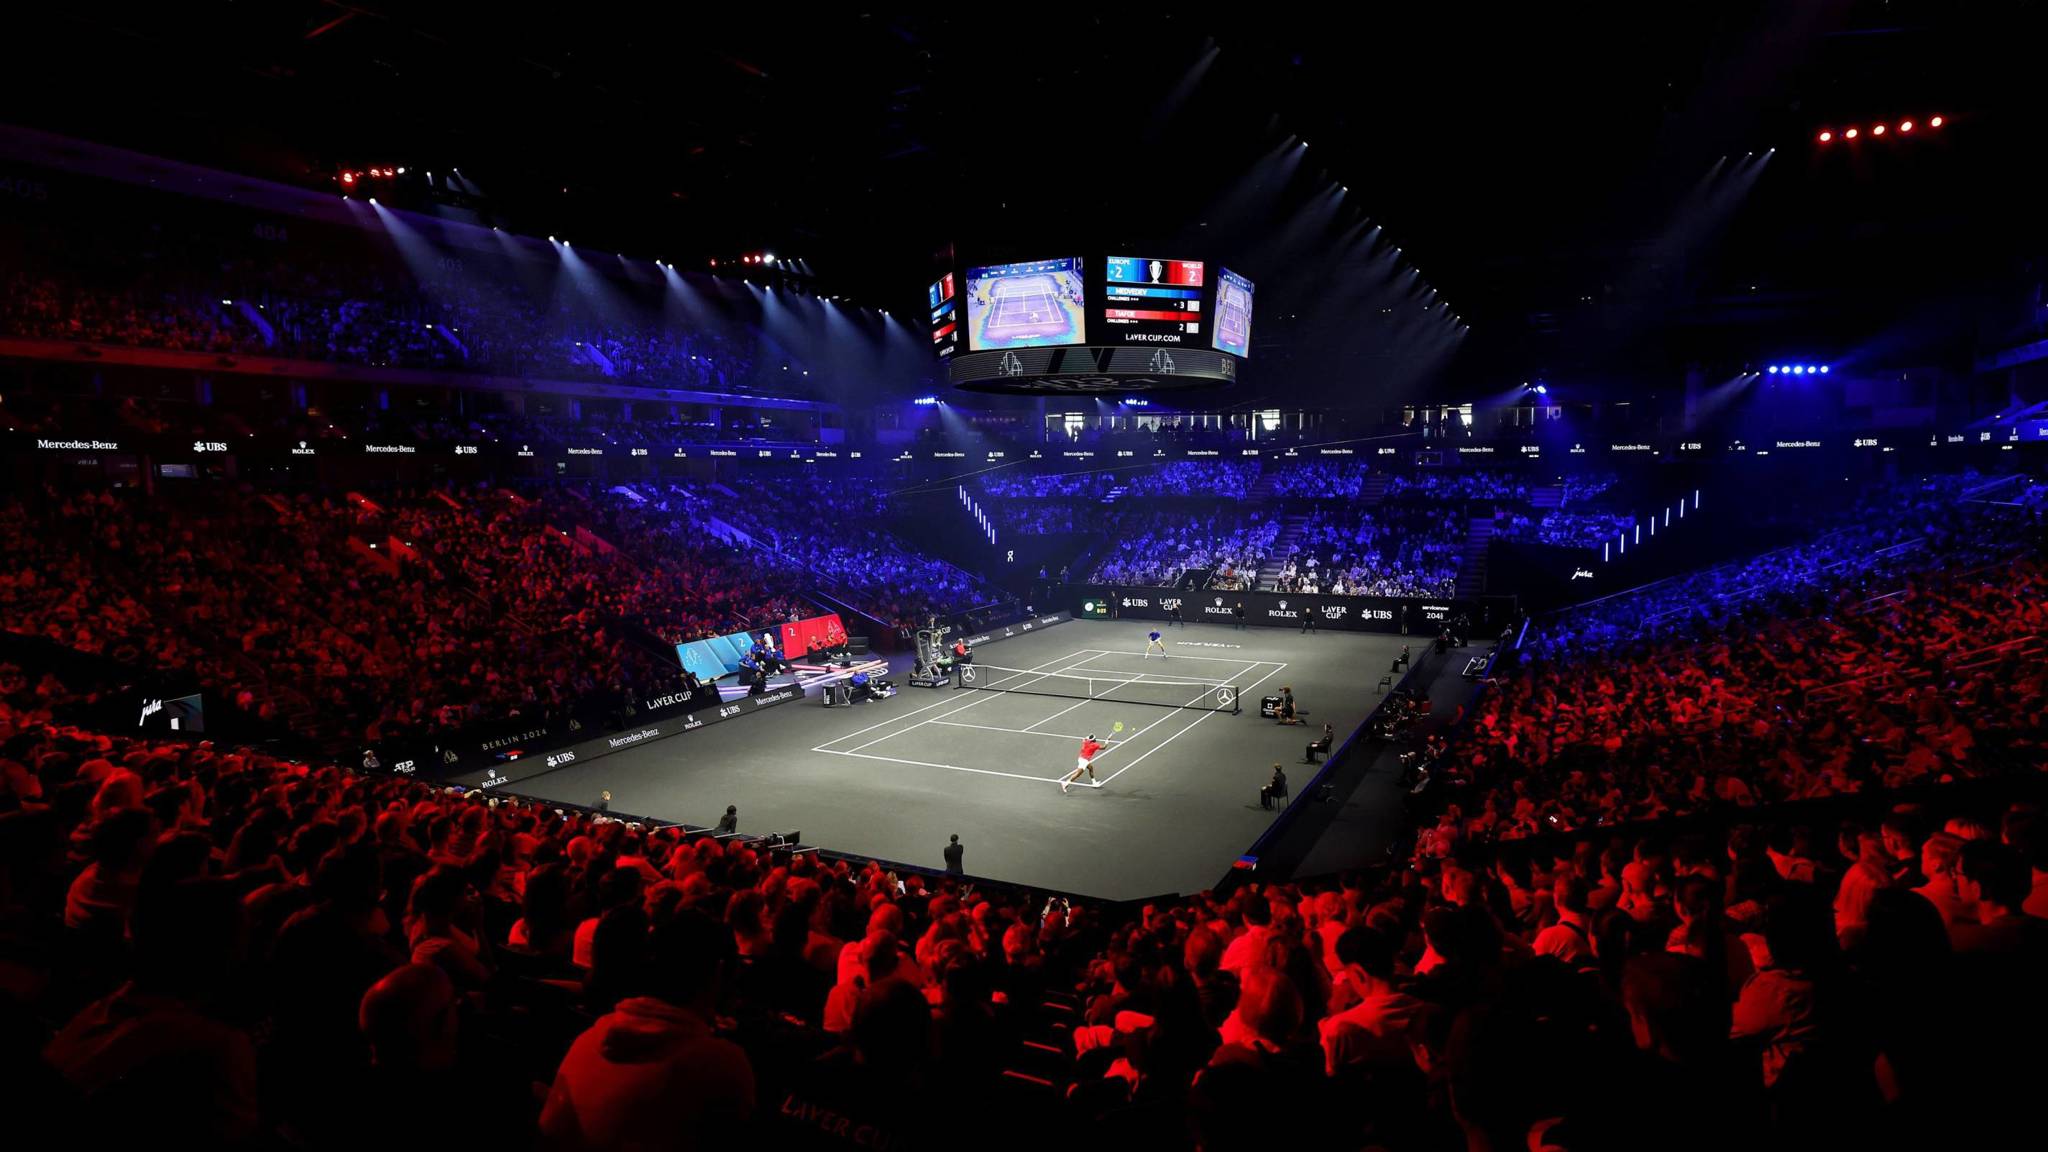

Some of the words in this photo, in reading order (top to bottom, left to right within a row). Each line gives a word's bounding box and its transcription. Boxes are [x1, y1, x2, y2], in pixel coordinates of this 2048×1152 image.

[1115, 266, 1123, 279] 2
[1189, 270, 1196, 282] 2
[1180, 301, 1185, 309] 3
[1179, 323, 1184, 331] 2
[1126, 333, 1147, 341] LAVER
[1148, 334, 1181, 342] CUP.COM
[38, 440, 117, 449] Mercedes-Benz
[206, 443, 227, 451] UBS
[463, 446, 477, 454] UBS
[1132, 599, 1148, 607] UBS
[1269, 609, 1297, 617] ROLEX
[1322, 606, 1347, 614] LAVER
[1373, 610, 1392, 619] UBS
[789, 628, 796, 636] 2
[739, 638, 746, 647] 2
[647, 695, 675, 709] LAVER
[675, 691, 692, 703] CUP
[755, 690, 793, 706] Mercedes-Benz
[727, 705, 741, 715] UBS
[684, 720, 703, 730] ROLEX
[482, 736, 520, 751] BERLIN
[523, 728, 548, 741] 2024
[609, 729, 660, 748] Mercedes-Benz
[556, 751, 575, 765] UBS
[394, 760, 414, 772] ATP
[402, 766, 416, 774] TOUR
[482, 776, 508, 789] ROLEX
